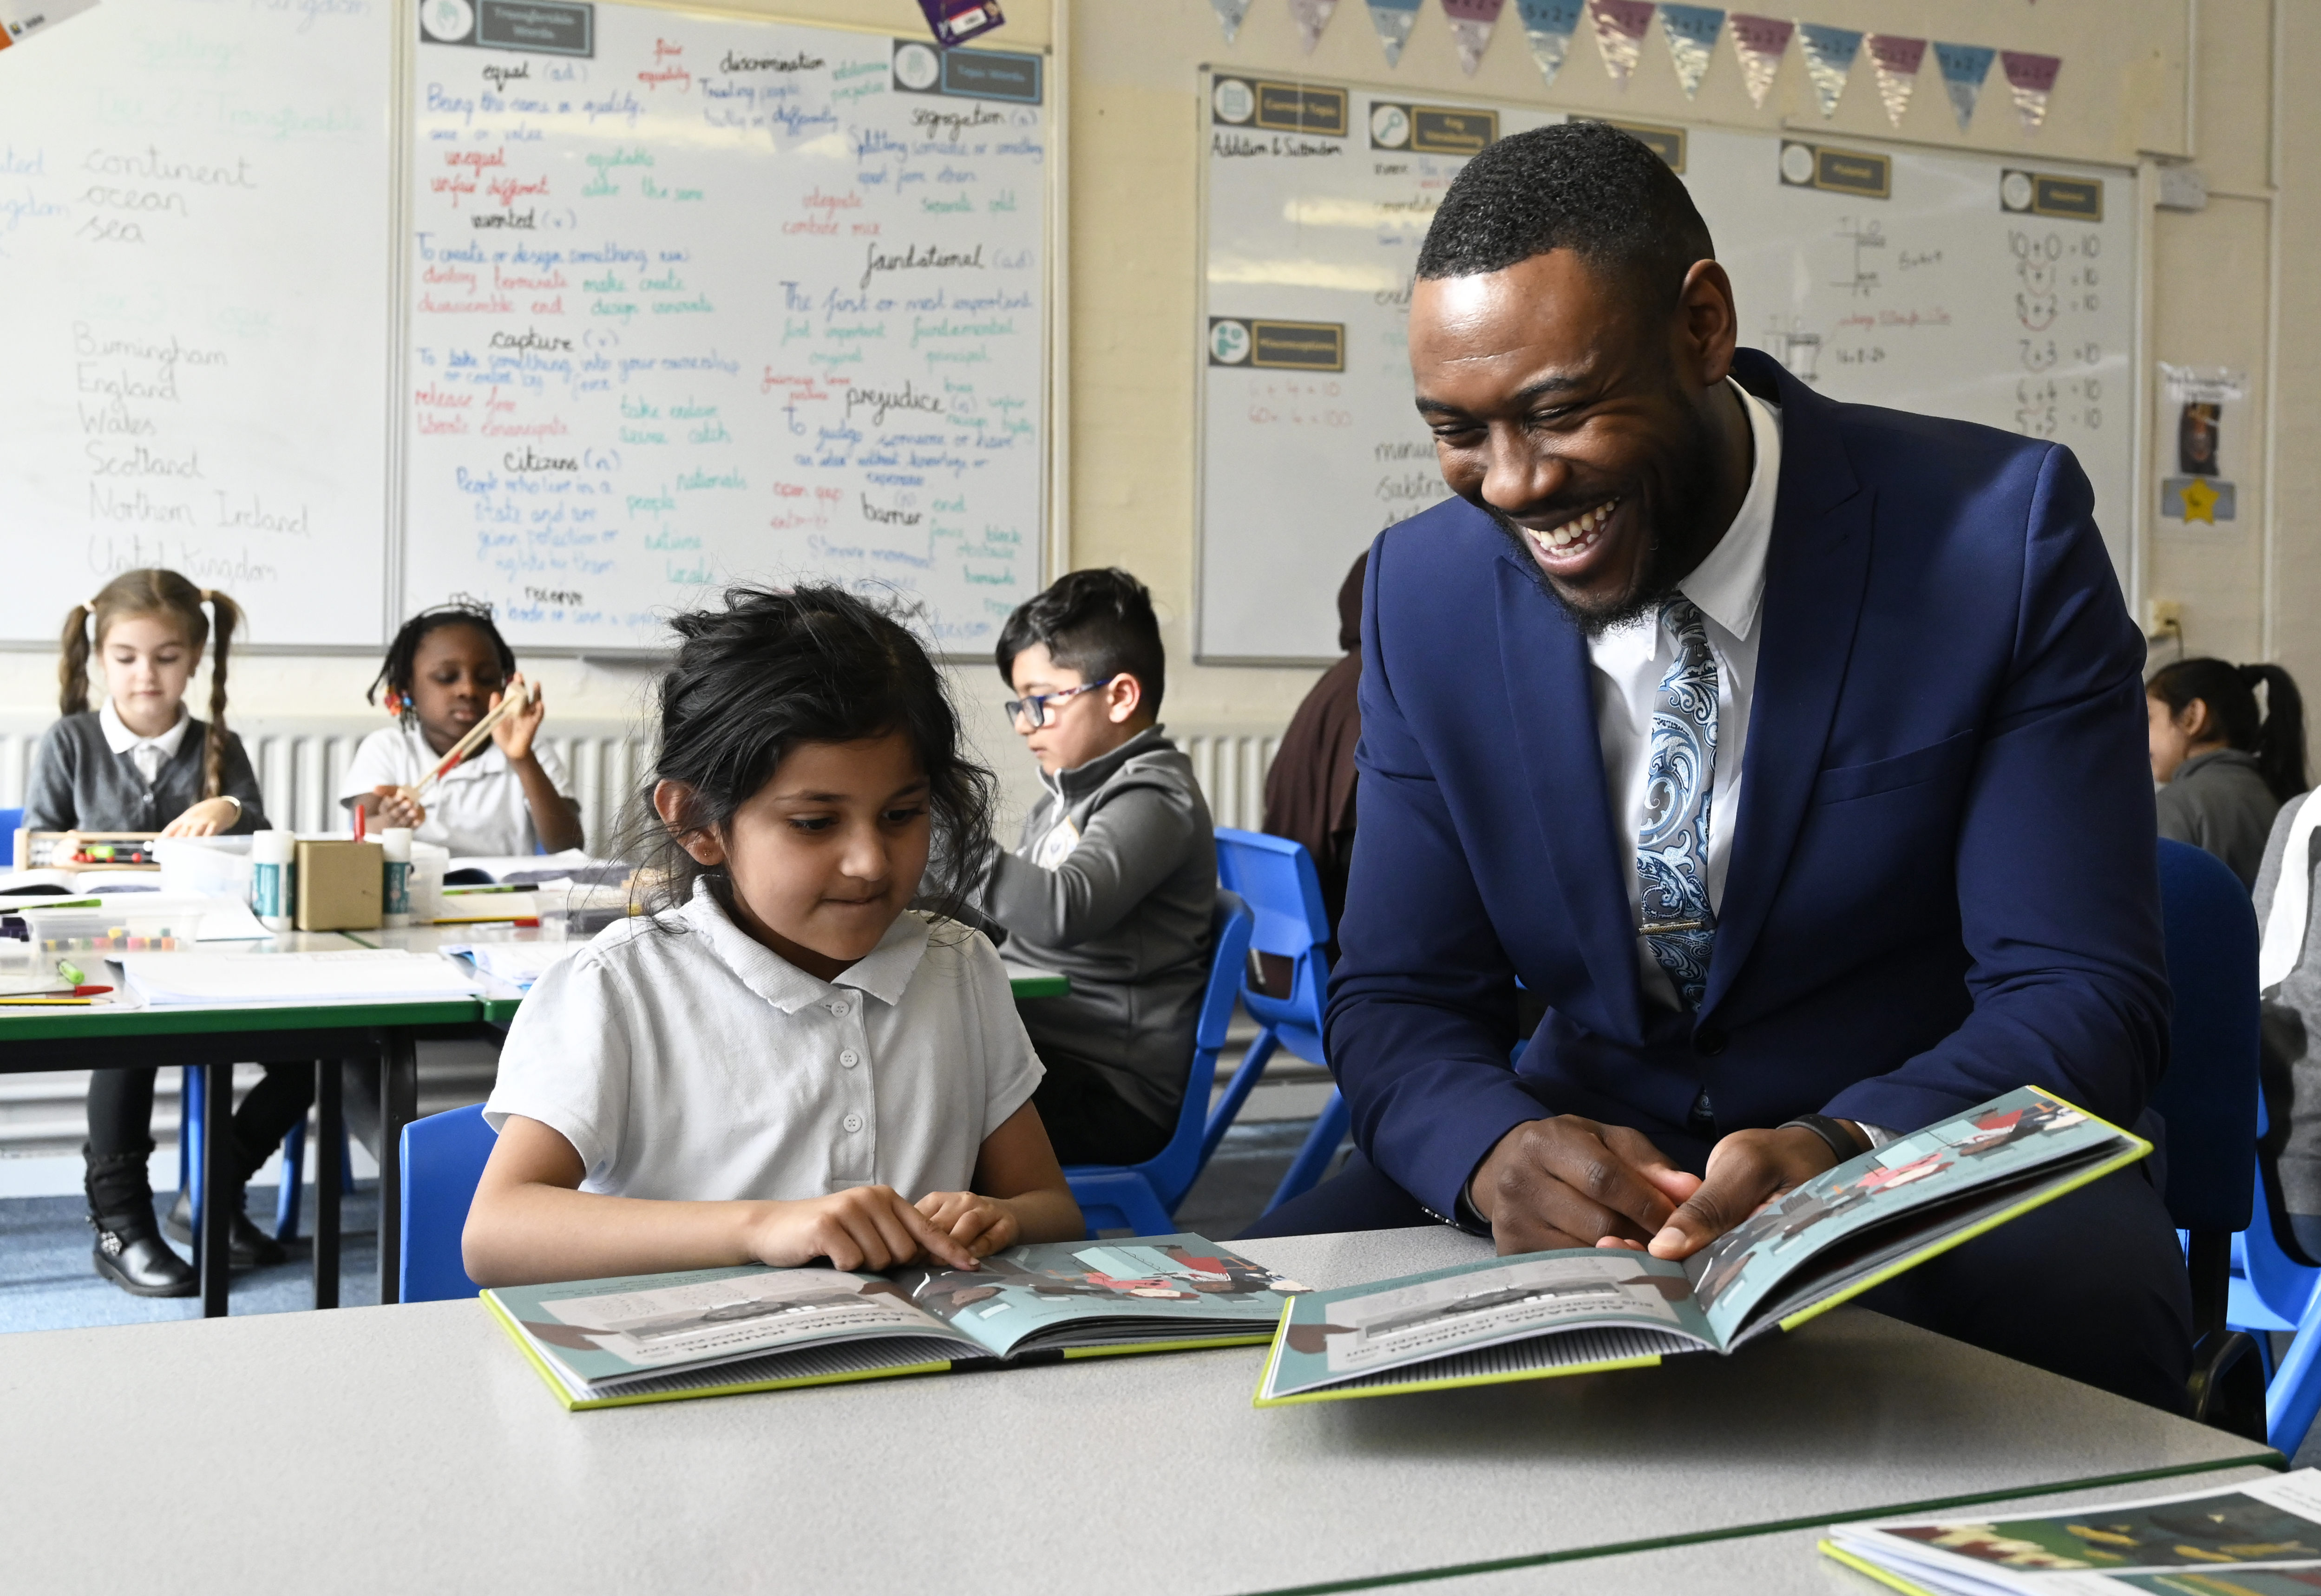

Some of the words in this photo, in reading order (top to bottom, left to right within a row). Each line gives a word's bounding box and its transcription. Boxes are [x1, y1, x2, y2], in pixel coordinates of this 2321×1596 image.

[81, 143, 259, 189] continent
[72, 184, 189, 218] ocean
[75, 215, 146, 244] sea
[76, 362, 180, 412] England
[78, 400, 157, 436] Wales
[85, 440, 206, 480] Scotland
[213, 489, 311, 538] Ireland
